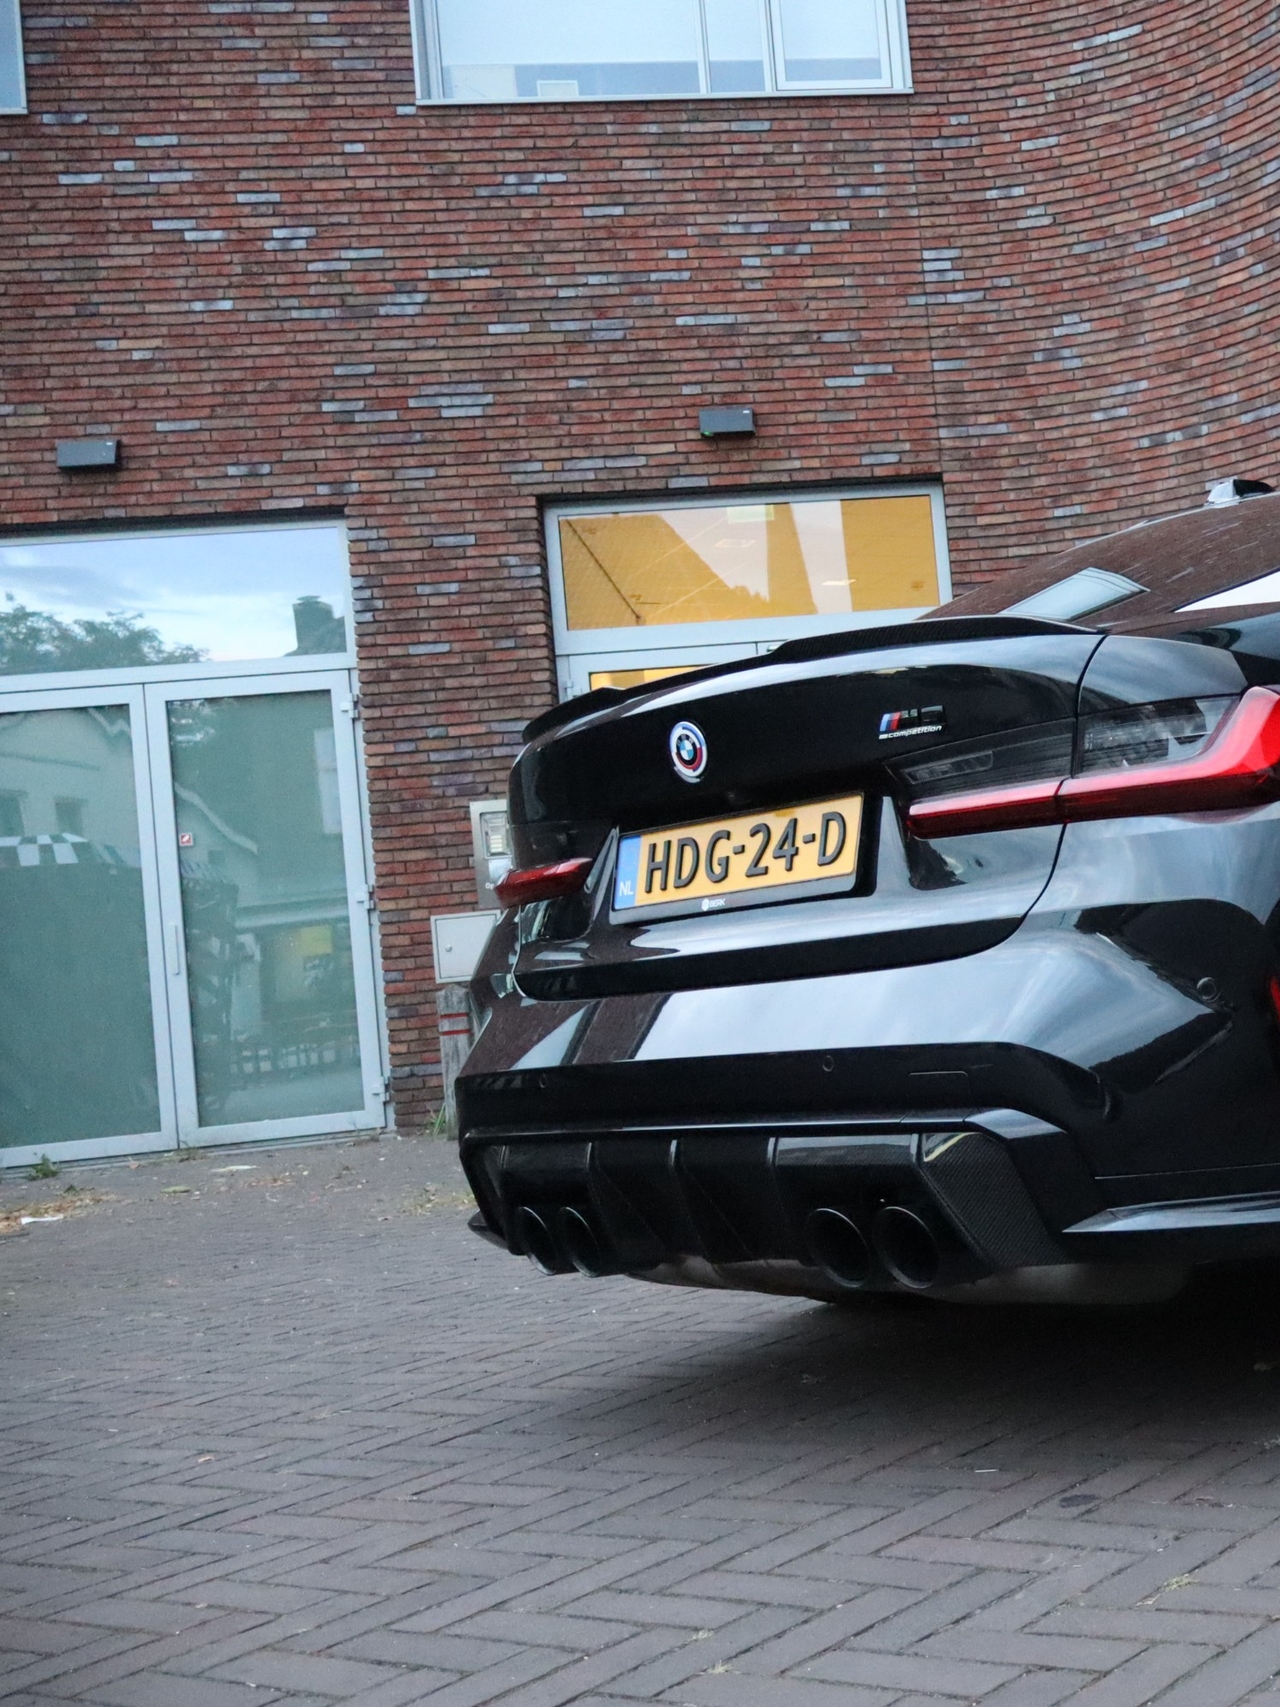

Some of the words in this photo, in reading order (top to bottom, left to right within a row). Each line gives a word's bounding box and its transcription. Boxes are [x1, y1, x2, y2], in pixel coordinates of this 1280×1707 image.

[888, 725, 943, 739] competition
[644, 811, 847, 894] HDG-24-D
[619, 880, 634, 896] NL
